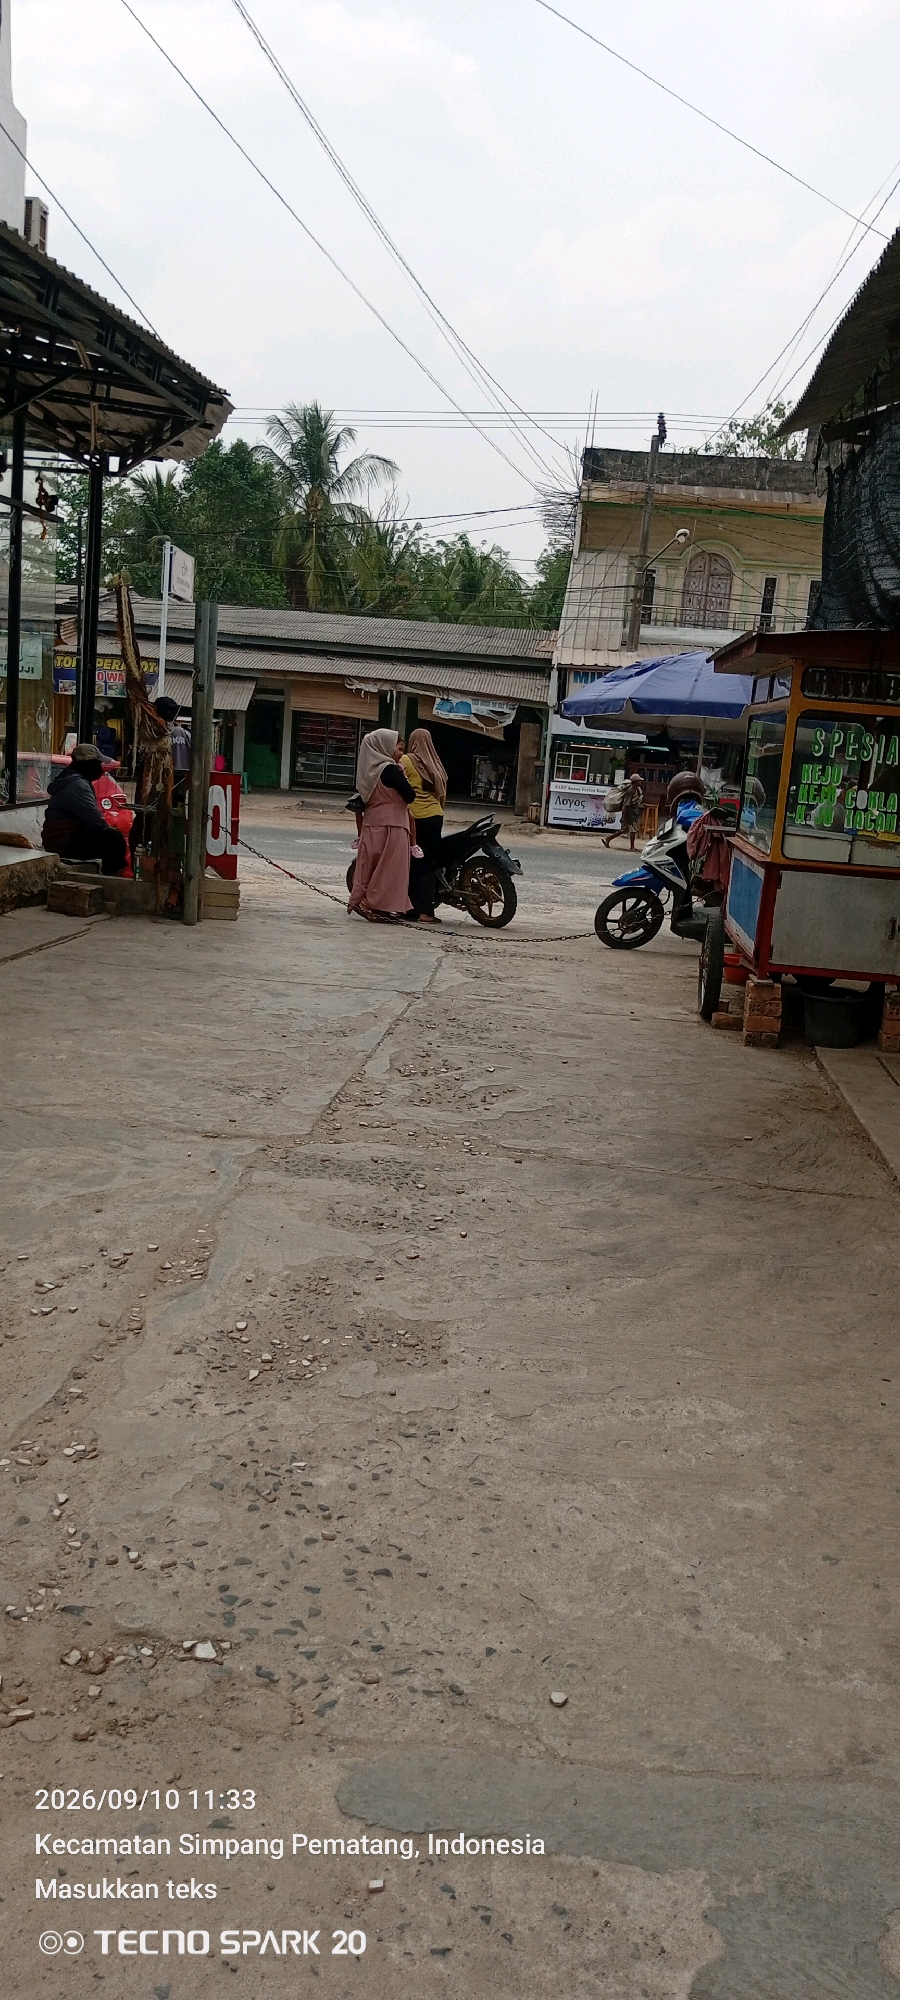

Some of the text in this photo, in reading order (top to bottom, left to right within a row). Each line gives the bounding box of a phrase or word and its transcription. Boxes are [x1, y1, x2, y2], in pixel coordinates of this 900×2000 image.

[96, 658, 157, 673] PERAOT
[801, 764, 843, 786] KEJU
[554, 795, 586, 809] Λογος
[798, 784, 838, 807] KEJU
